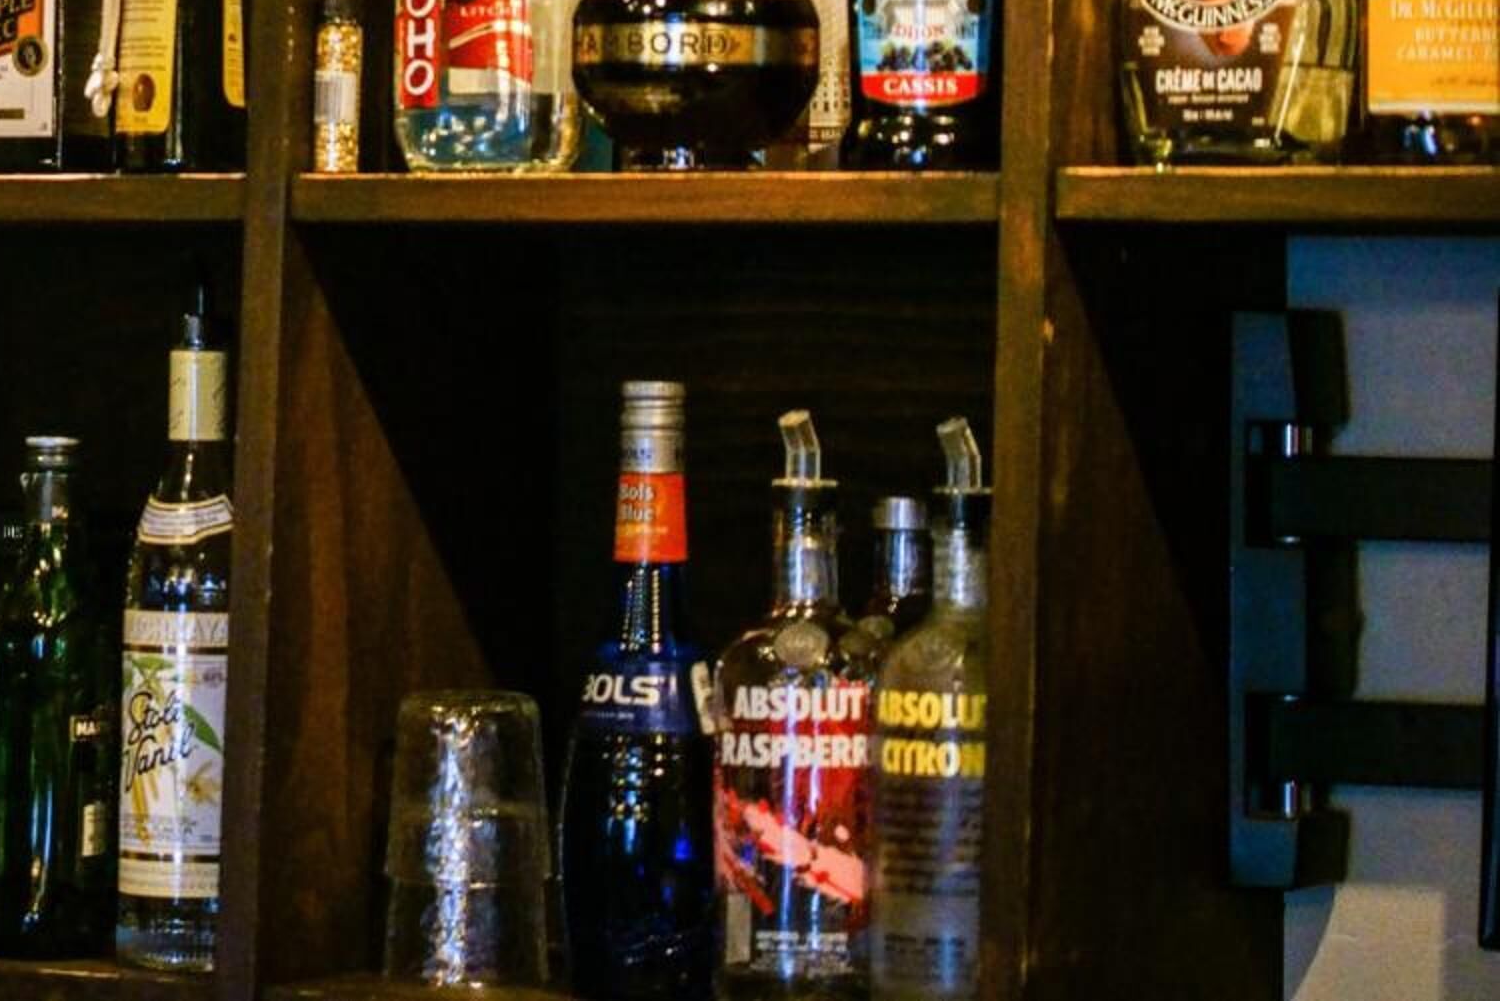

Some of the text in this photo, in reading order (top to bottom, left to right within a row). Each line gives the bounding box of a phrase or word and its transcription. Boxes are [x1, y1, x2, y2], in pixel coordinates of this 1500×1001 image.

[883, 78, 959, 95] CASSIS
[1217, 67, 1263, 92] CACAO
[127, 690, 181, 745] Stoli
[732, 686, 866, 721] ABSOLUT
[121, 722, 196, 794] Vanil
[722, 734, 869, 769] RASPBERR
[881, 741, 986, 777] CITRON
